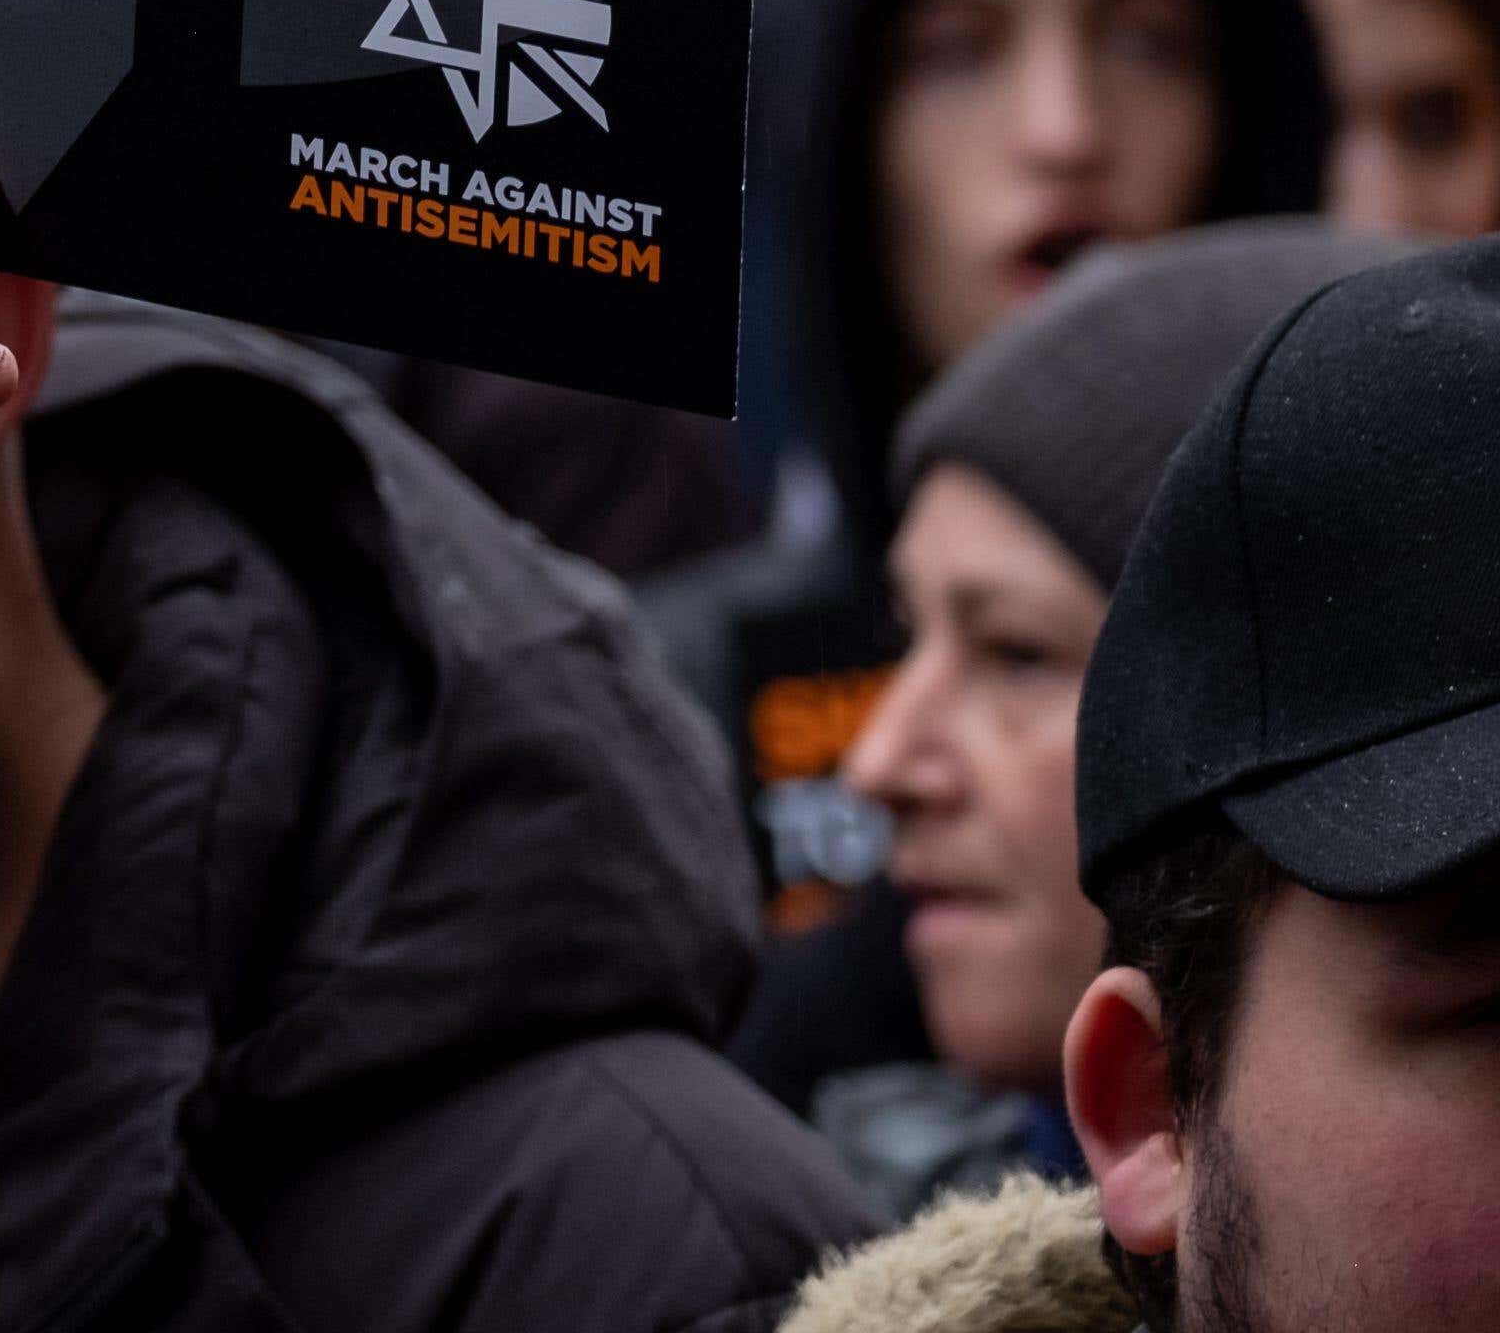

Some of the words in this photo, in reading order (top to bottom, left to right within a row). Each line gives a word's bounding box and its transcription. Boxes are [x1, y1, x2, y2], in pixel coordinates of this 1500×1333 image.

[289, 174, 662, 283] ANTISEMITISM
[290, 133, 450, 196] MARCH
[462, 170, 663, 237] AGAINST
